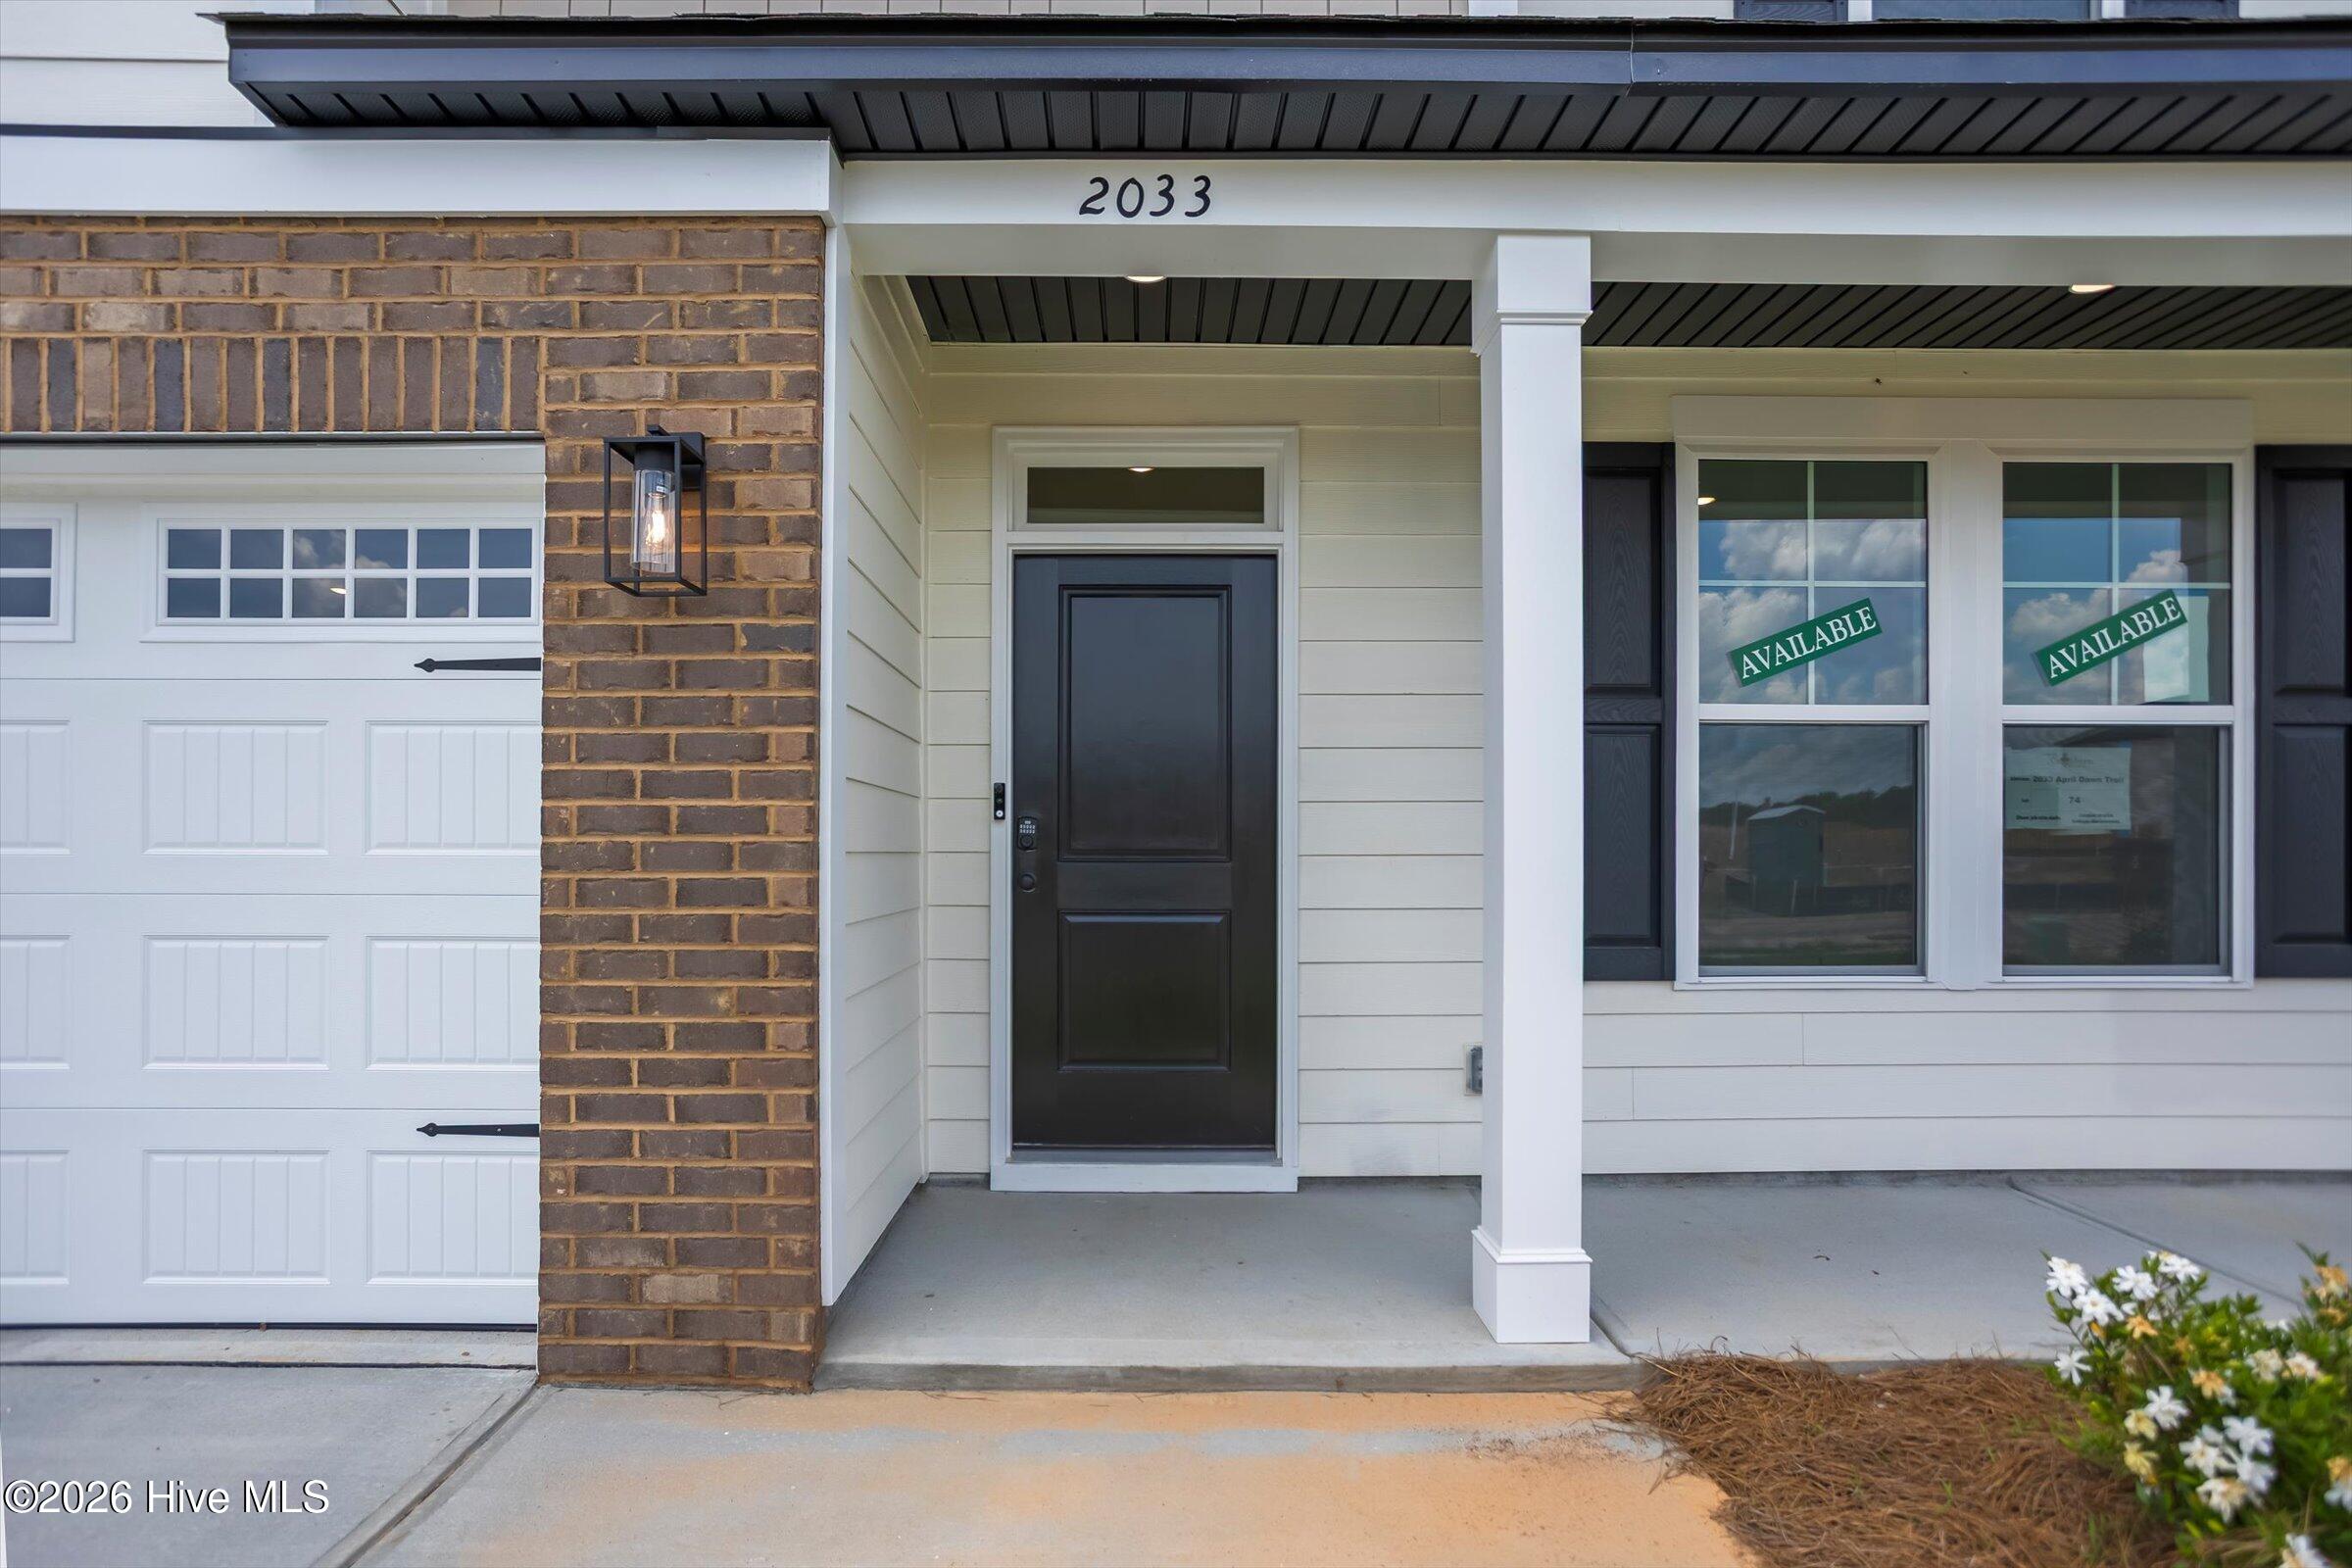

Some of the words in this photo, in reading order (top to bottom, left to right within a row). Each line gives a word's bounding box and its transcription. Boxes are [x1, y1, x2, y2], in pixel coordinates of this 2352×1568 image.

[1078, 173, 1211, 219] 2033
[1740, 605, 1878, 681] AVAILABLE
[2047, 596, 2182, 680] AVAILABLE
[2055, 775, 2078, 784] April
